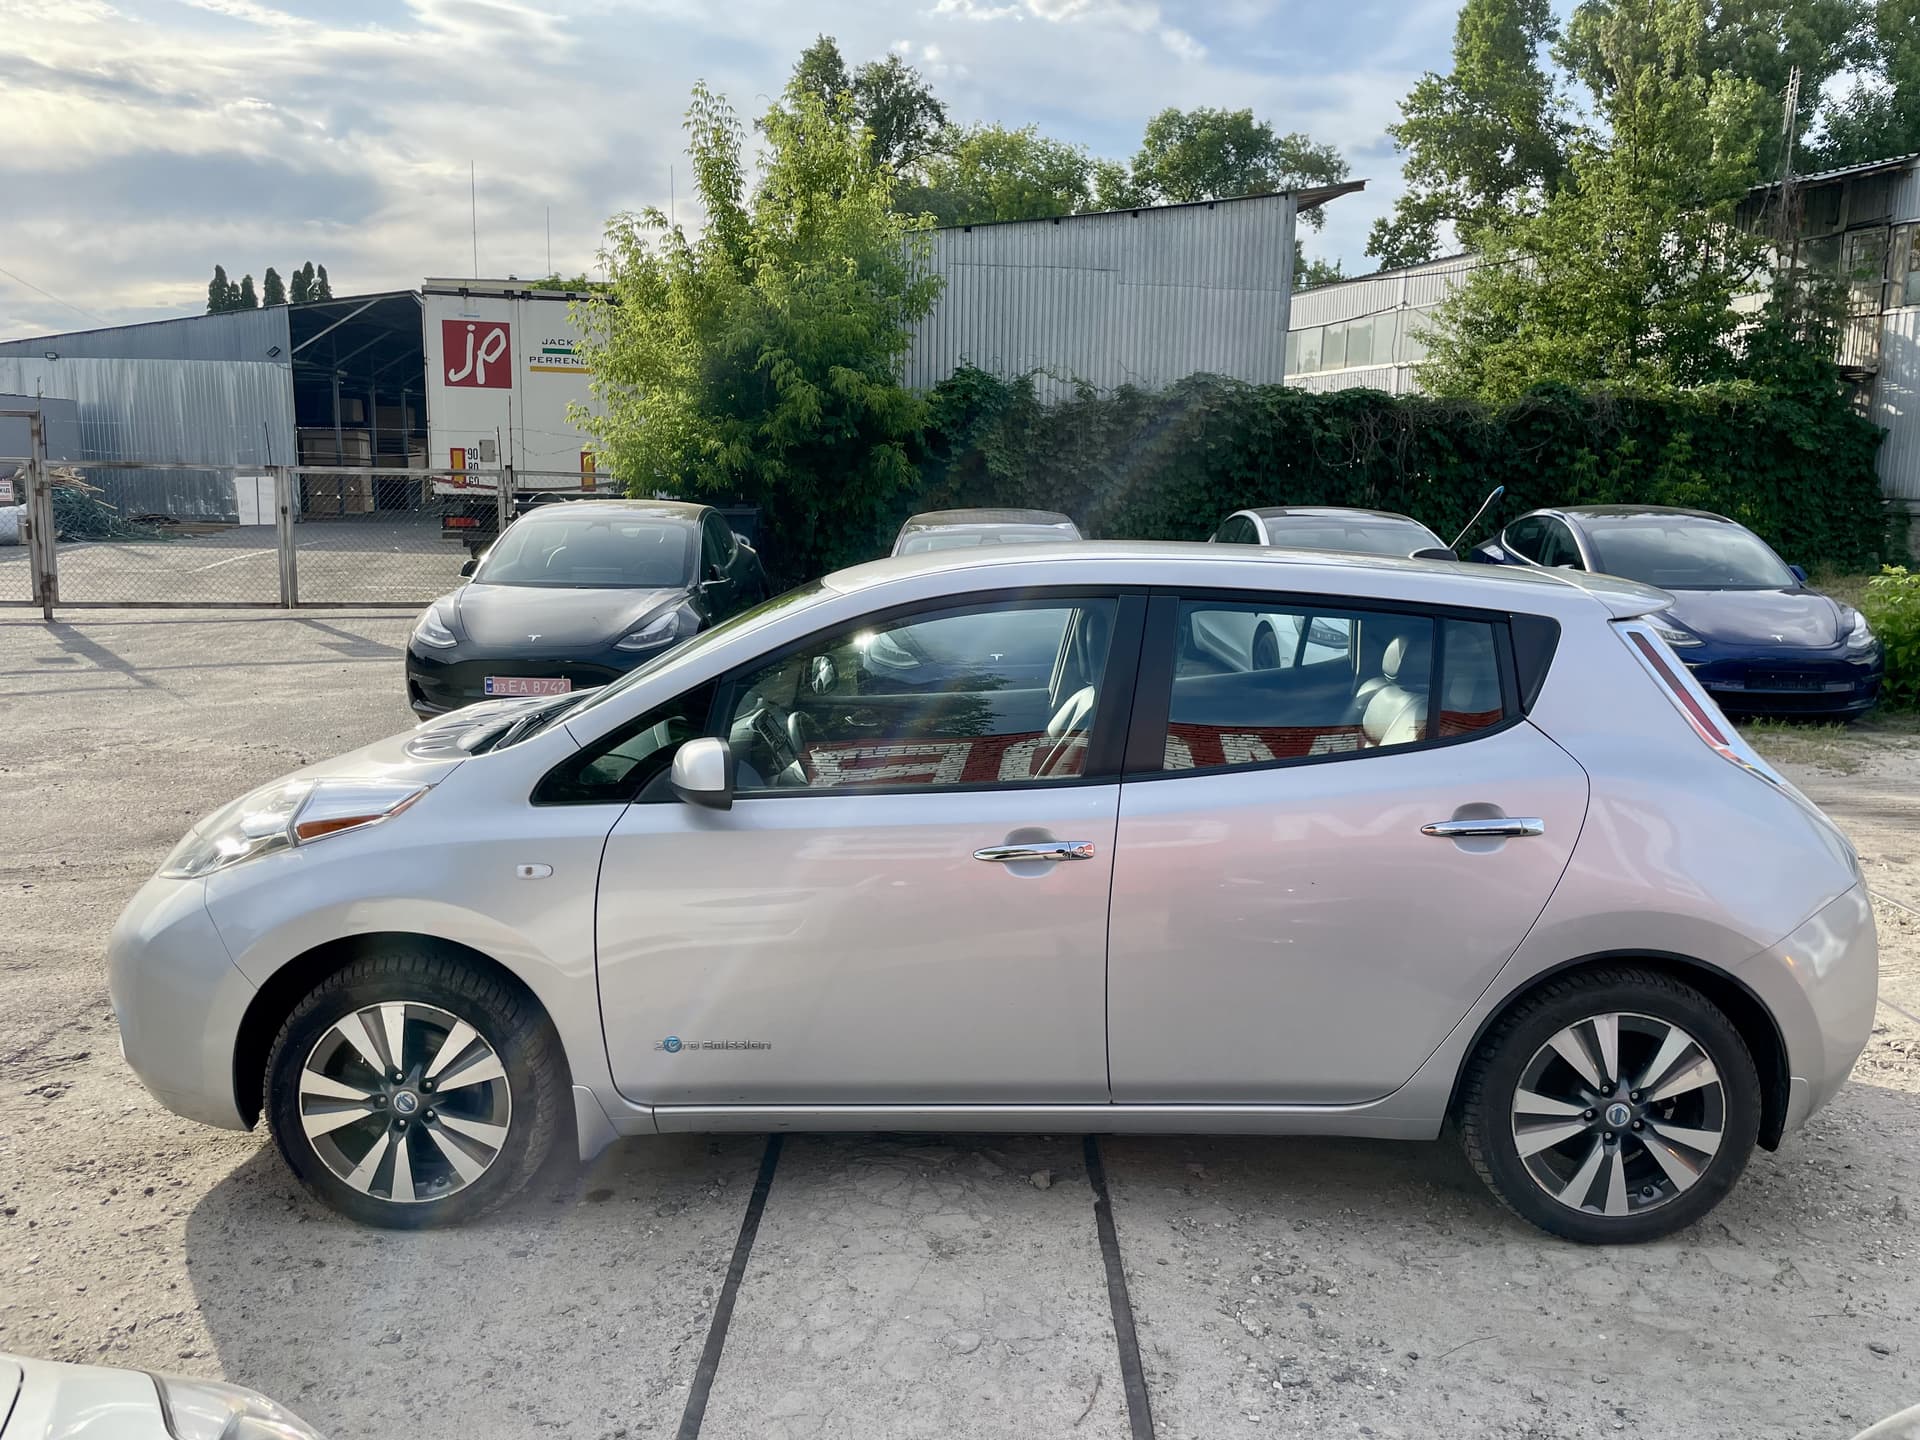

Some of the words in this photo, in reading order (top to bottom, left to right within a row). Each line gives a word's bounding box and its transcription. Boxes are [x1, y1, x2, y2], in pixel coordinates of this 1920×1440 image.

[541, 338, 582, 347] JACK
[529, 355, 589, 366] PERRENO
[467, 447, 479, 460] 90
[508, 680, 529, 694] EA
[533, 681, 566, 694] 8742
